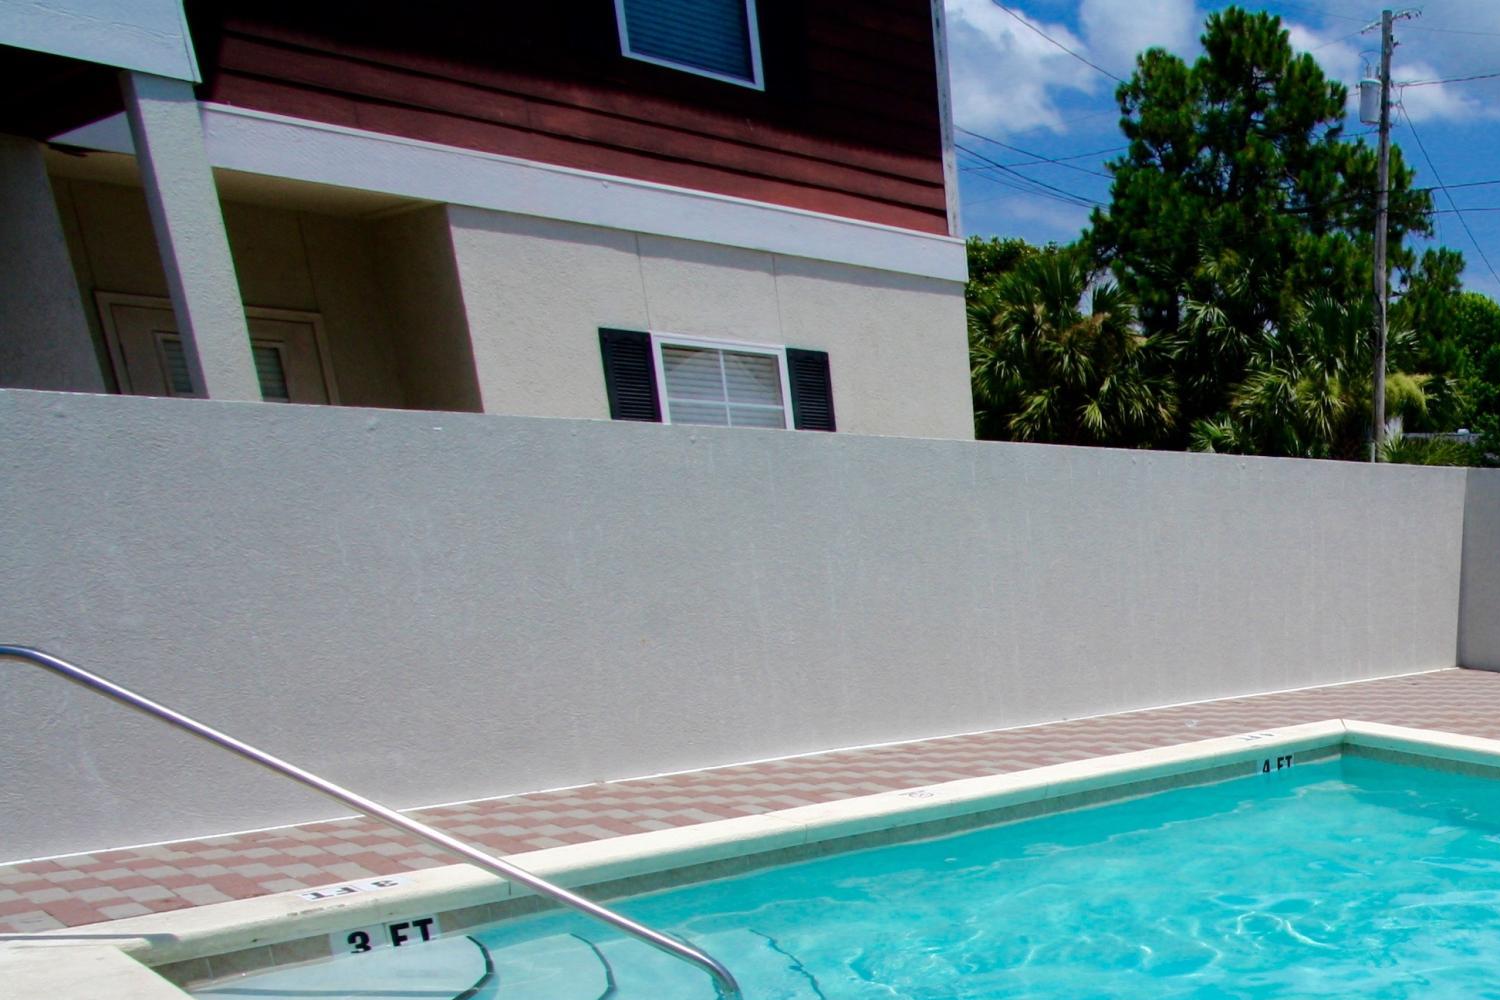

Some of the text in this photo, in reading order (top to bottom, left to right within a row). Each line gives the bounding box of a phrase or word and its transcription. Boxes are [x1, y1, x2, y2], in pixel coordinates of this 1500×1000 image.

[1262, 755, 1293, 773] 4 FT
[347, 918, 433, 954] 3 FT
